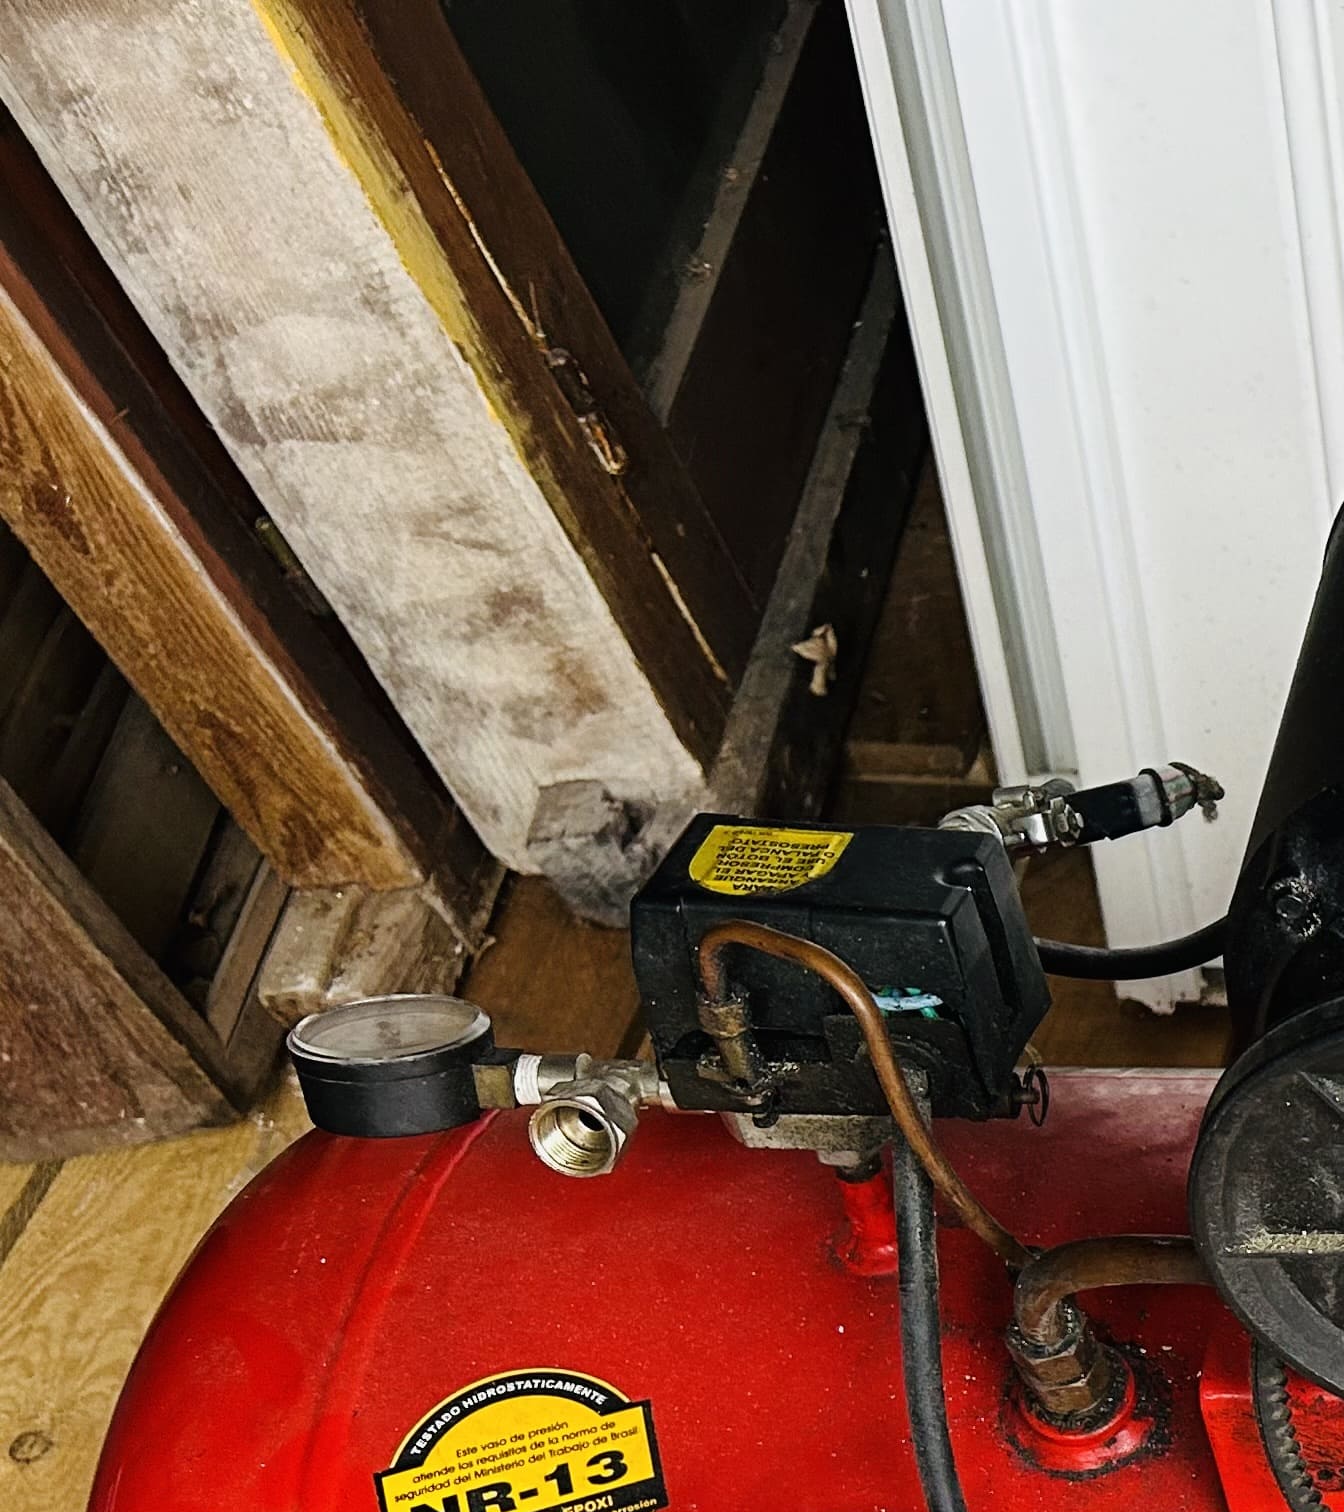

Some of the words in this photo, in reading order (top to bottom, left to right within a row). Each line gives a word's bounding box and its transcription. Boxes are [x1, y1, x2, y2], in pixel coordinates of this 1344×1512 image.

[718, 860, 815, 872] COMPRESOR
[730, 839, 830, 849] PRESOSTATO
[410, 1405, 461, 1457] TESTADO
[461, 1379, 609, 1410] HIDROSTATICAMENTE
[456, 1446, 478, 1458] Este
[480, 1438, 507, 1451] vaso
[510, 1433, 525, 1443] de
[528, 1421, 569, 1440] presión
[394, 1480, 450, 1503] seguridad
[454, 1473, 472, 1485] del
[474, 1459, 525, 1479] Ministerio
[528, 1452, 546, 1464] del
[549, 1441, 590, 1458] Trabajo
[592, 1436, 608, 1446] de
[412, 1466, 455, 1484] atiende
[458, 1461, 474, 1471] los
[476, 1445, 527, 1466] requisitos
[530, 1440, 545, 1451] de
[548, 1436, 559, 1446] la
[561, 1426, 598, 1442] norma
[600, 1421, 616, 1431] de
